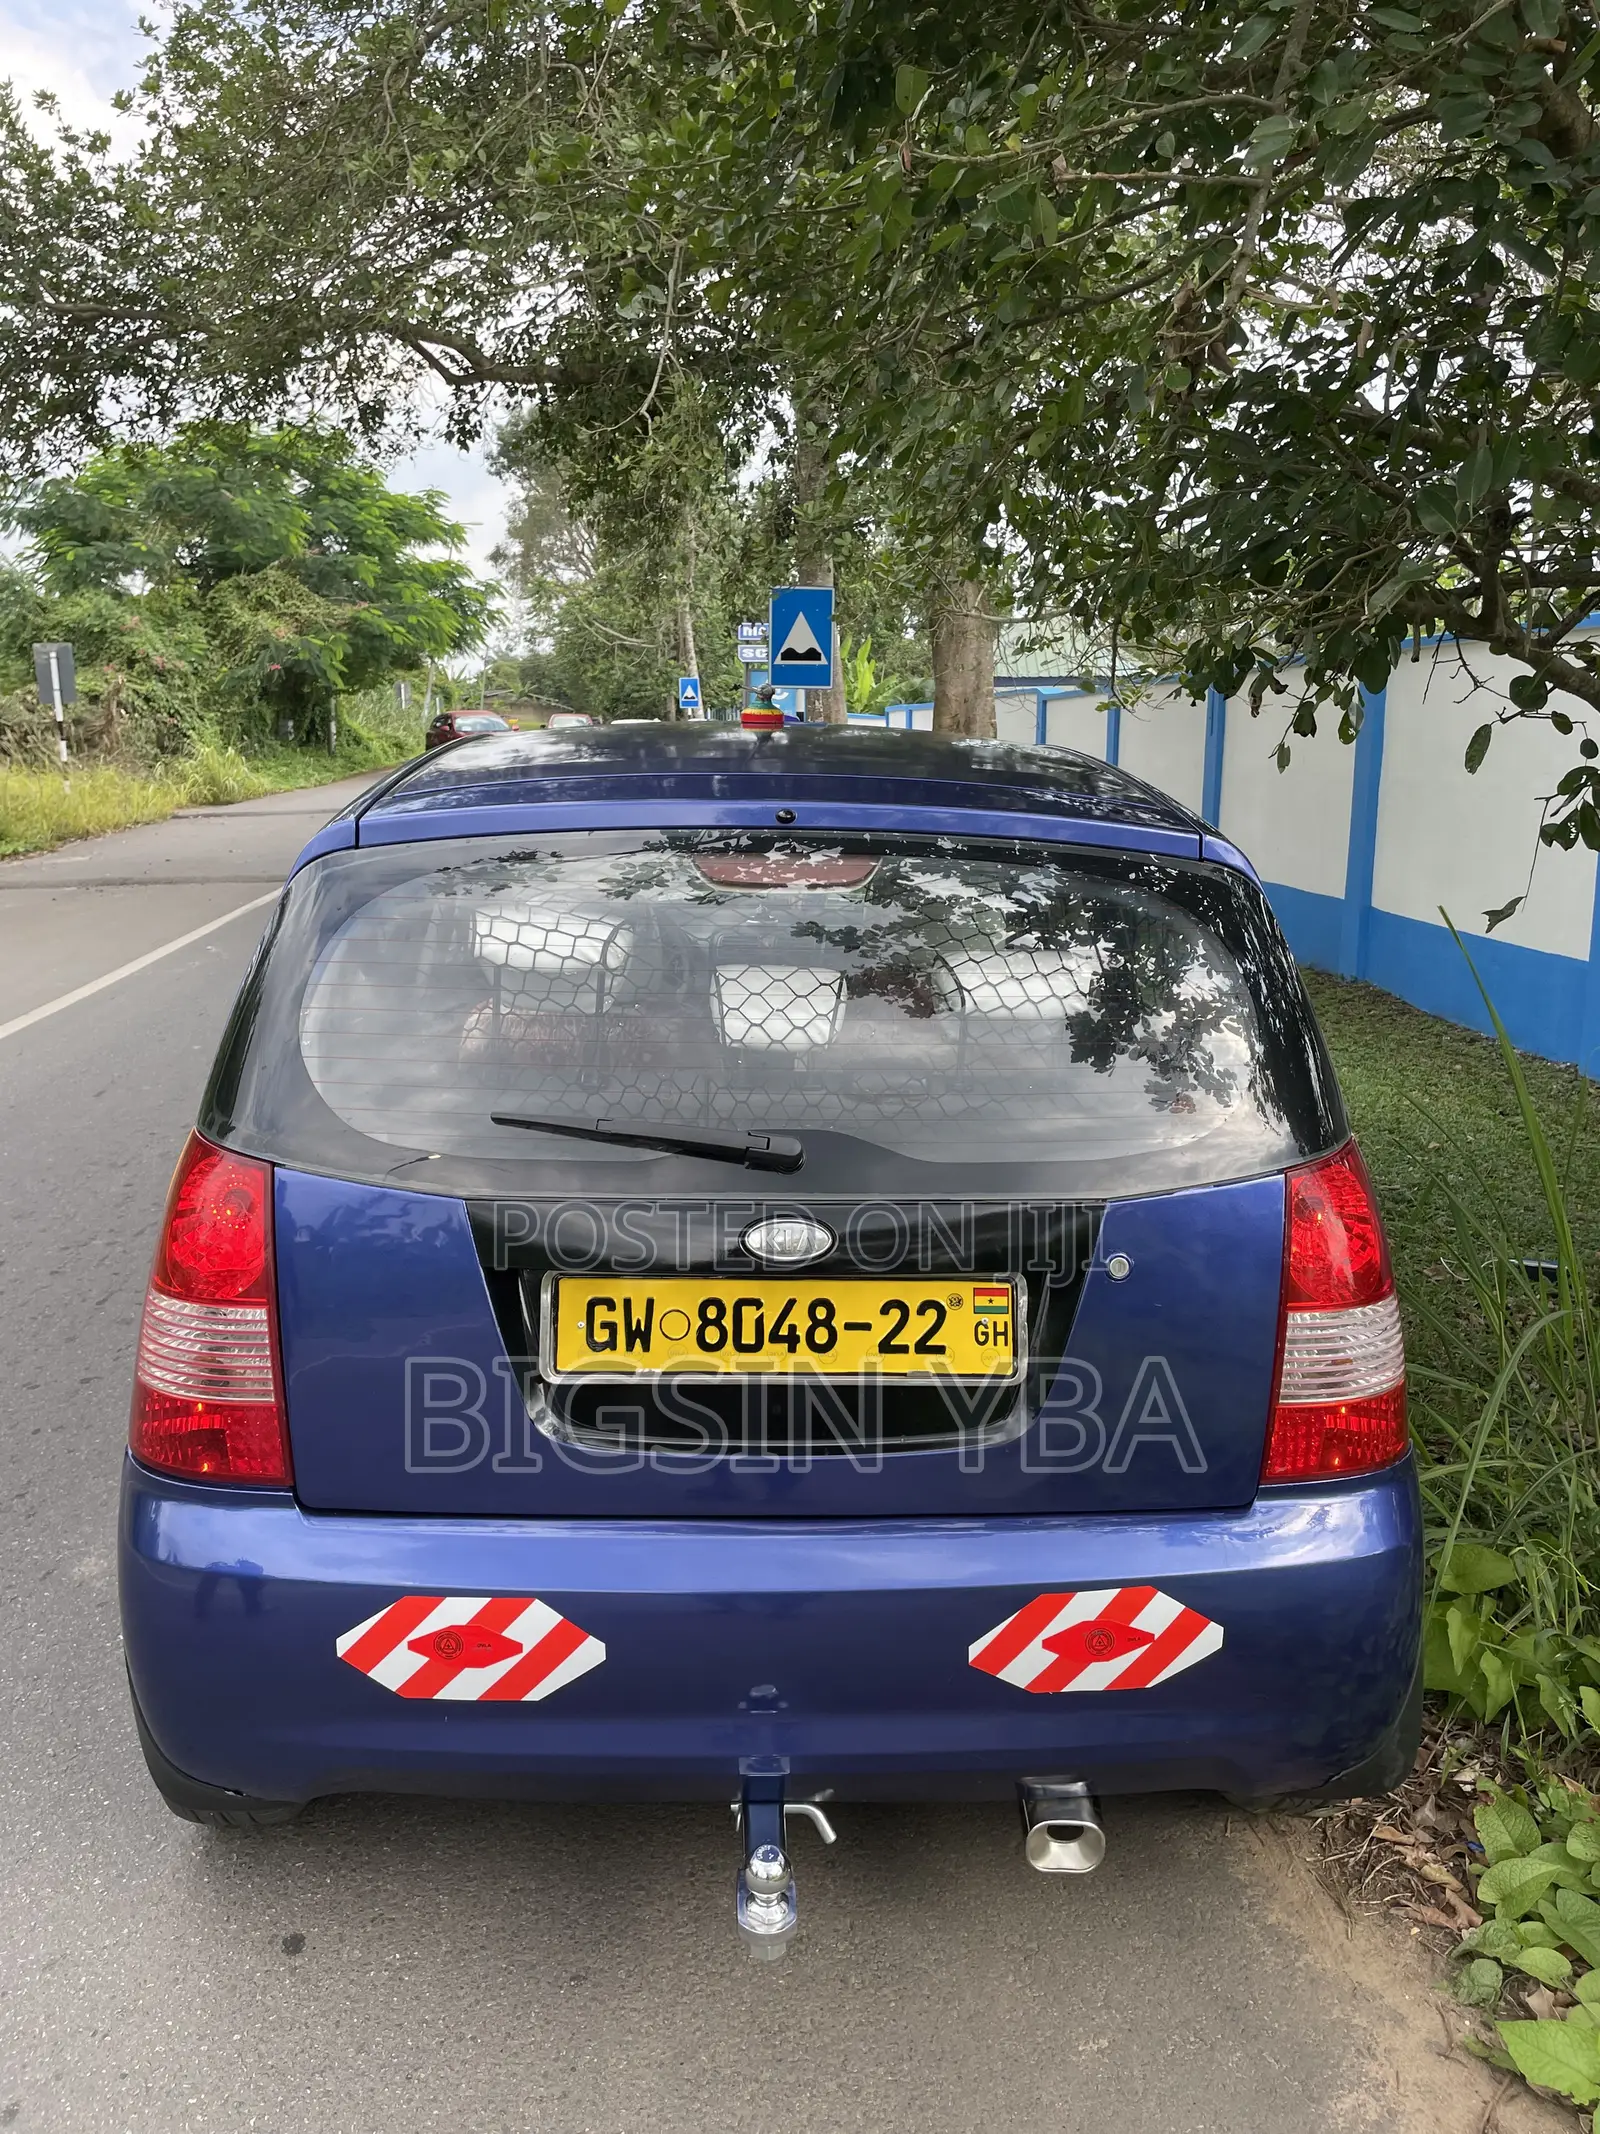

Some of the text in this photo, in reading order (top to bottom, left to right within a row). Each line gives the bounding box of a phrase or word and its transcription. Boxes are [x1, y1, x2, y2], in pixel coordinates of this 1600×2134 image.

[759, 1228, 818, 1252] KIA
[584, 1296, 948, 1355] GW 8048-22
[973, 1320, 1009, 1347] GH
